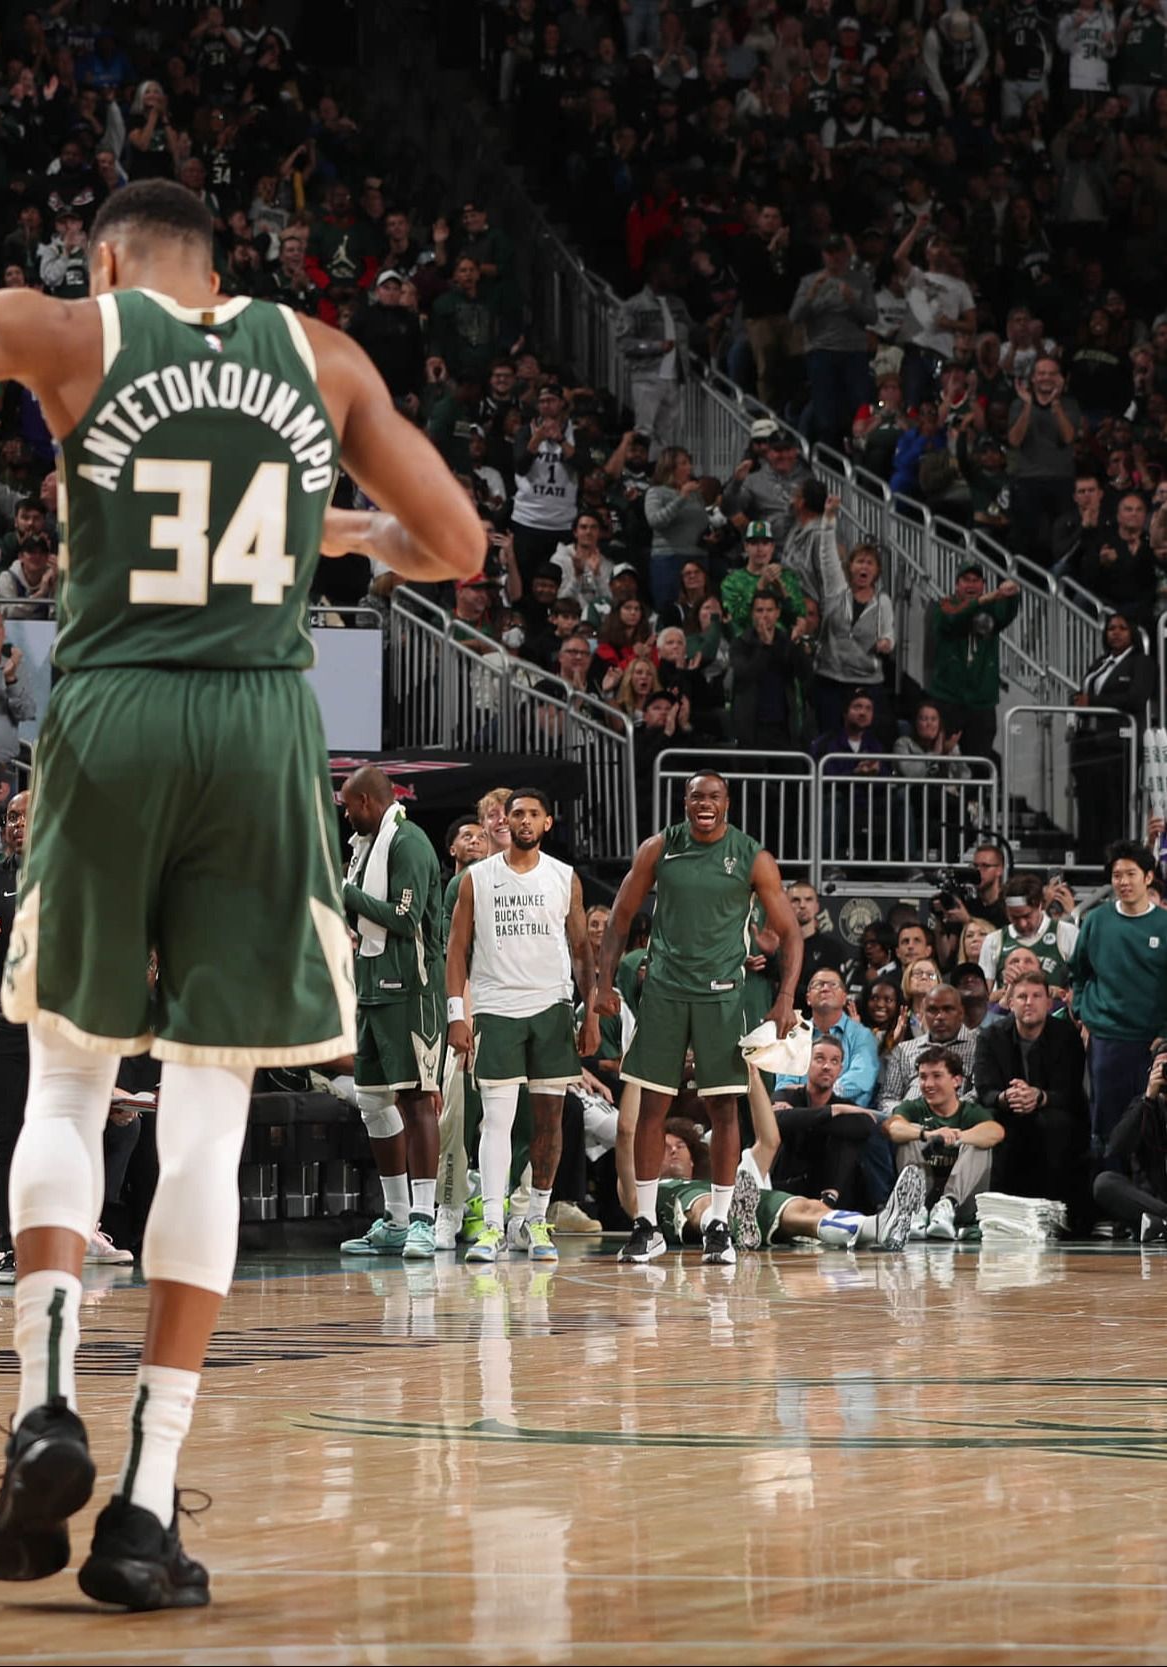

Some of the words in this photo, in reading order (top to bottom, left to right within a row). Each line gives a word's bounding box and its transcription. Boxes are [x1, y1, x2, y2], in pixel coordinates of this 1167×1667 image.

[212, 166, 232, 184] 34
[77, 359, 333, 494] ANTETOKOUNMPO
[548, 465, 556, 484] 1
[129, 457, 296, 607] 34
[494, 895, 544, 908] MILWAUKEE
[495, 910, 525, 922] BUCKS
[496, 924, 549, 937] BASKETBALL
